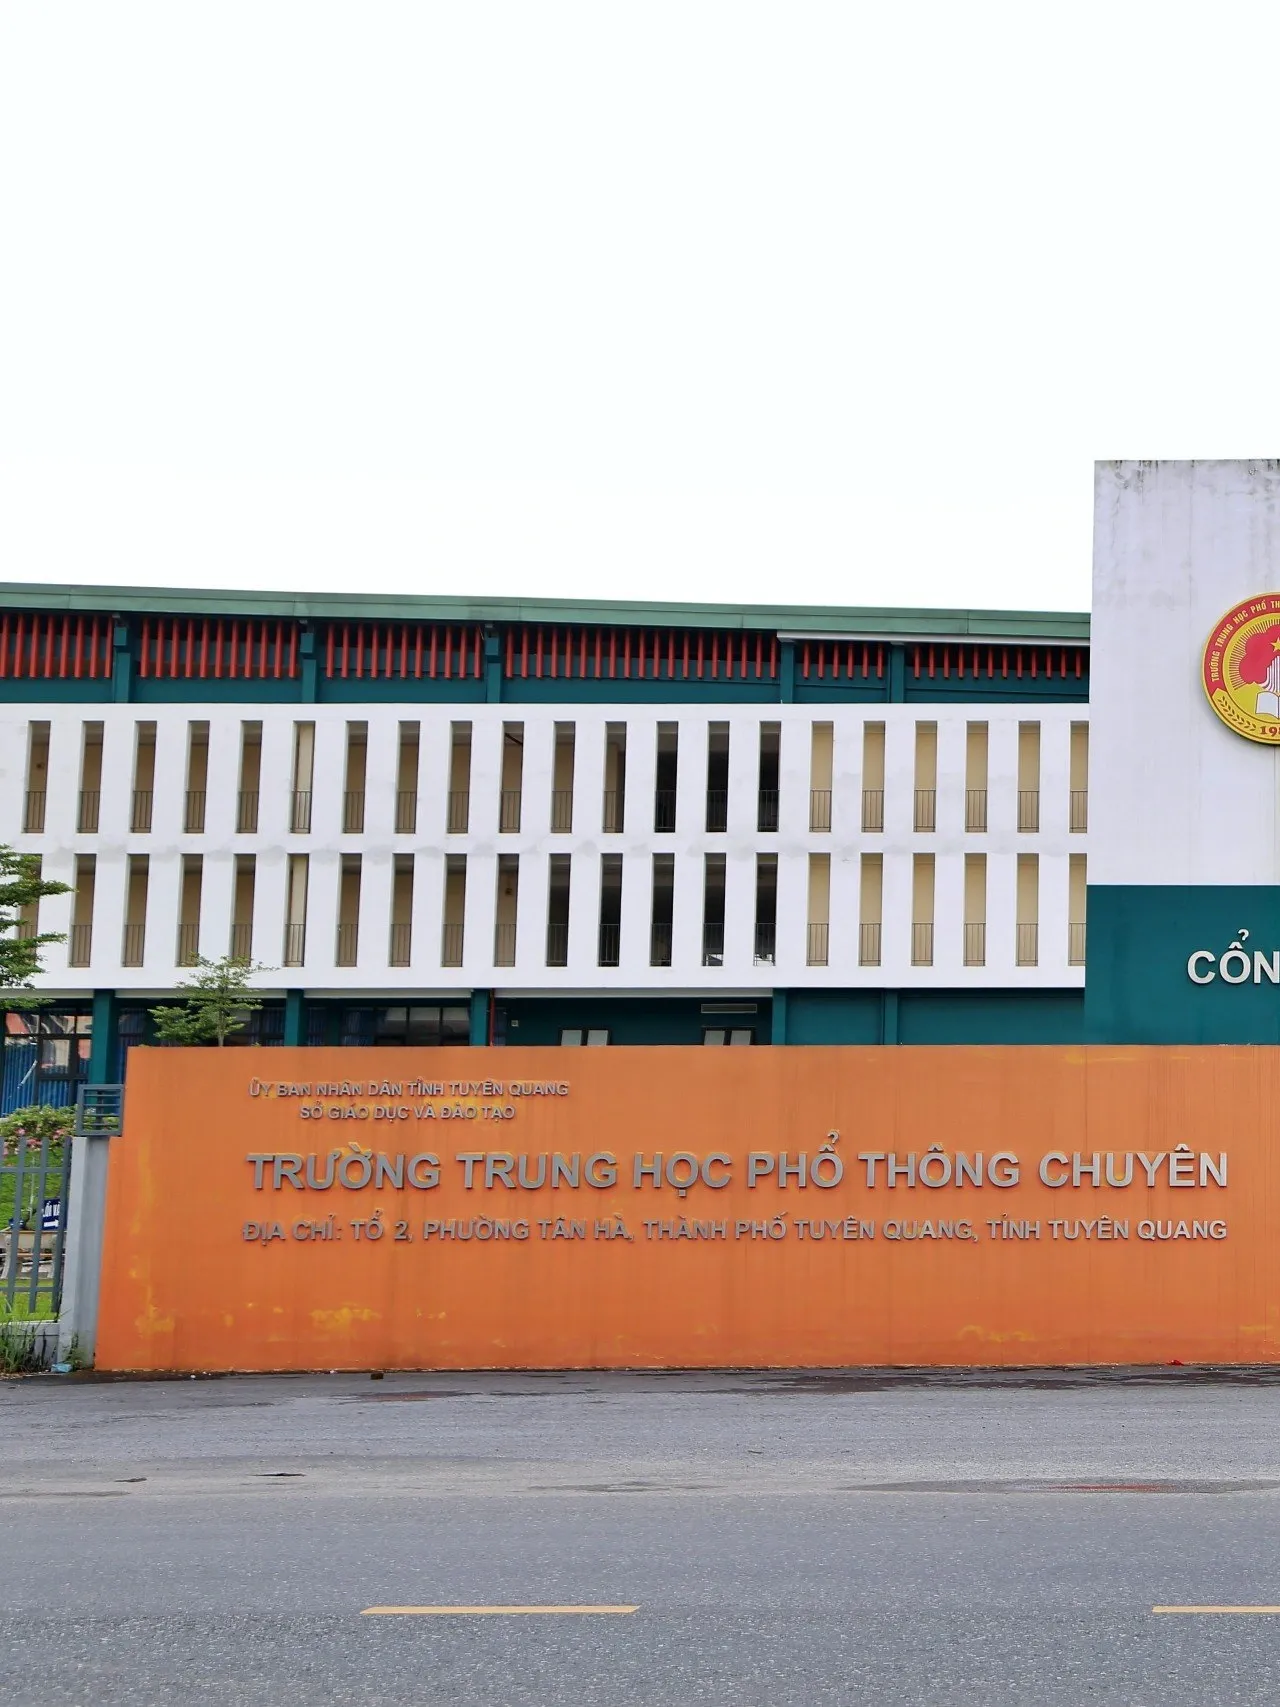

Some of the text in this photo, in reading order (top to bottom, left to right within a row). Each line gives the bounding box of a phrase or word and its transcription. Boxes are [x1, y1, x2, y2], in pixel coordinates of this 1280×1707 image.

[1215, 623, 1234, 648] TRUNG
[1232, 610, 1249, 624] HỌC
[249, 1076, 570, 1097] ỦY BAN NHÂN DÂN TỈNH TUYÊN QUANG
[300, 1100, 517, 1123] SỞ GIÁO DỤC VÀ ĐÀO TẠO
[246, 1129, 1229, 1197] TRƯỜNG TRUNG HỌC PHỔ THÔNG CHUYÊN
[242, 1207, 1228, 1246] ĐỊA CHỈ: TỔ 2, PHƯỜNG TÂN HÀ, THÀNH PHỐ TUYÊN QUANG, TỈNH TUYÊN QUANG
